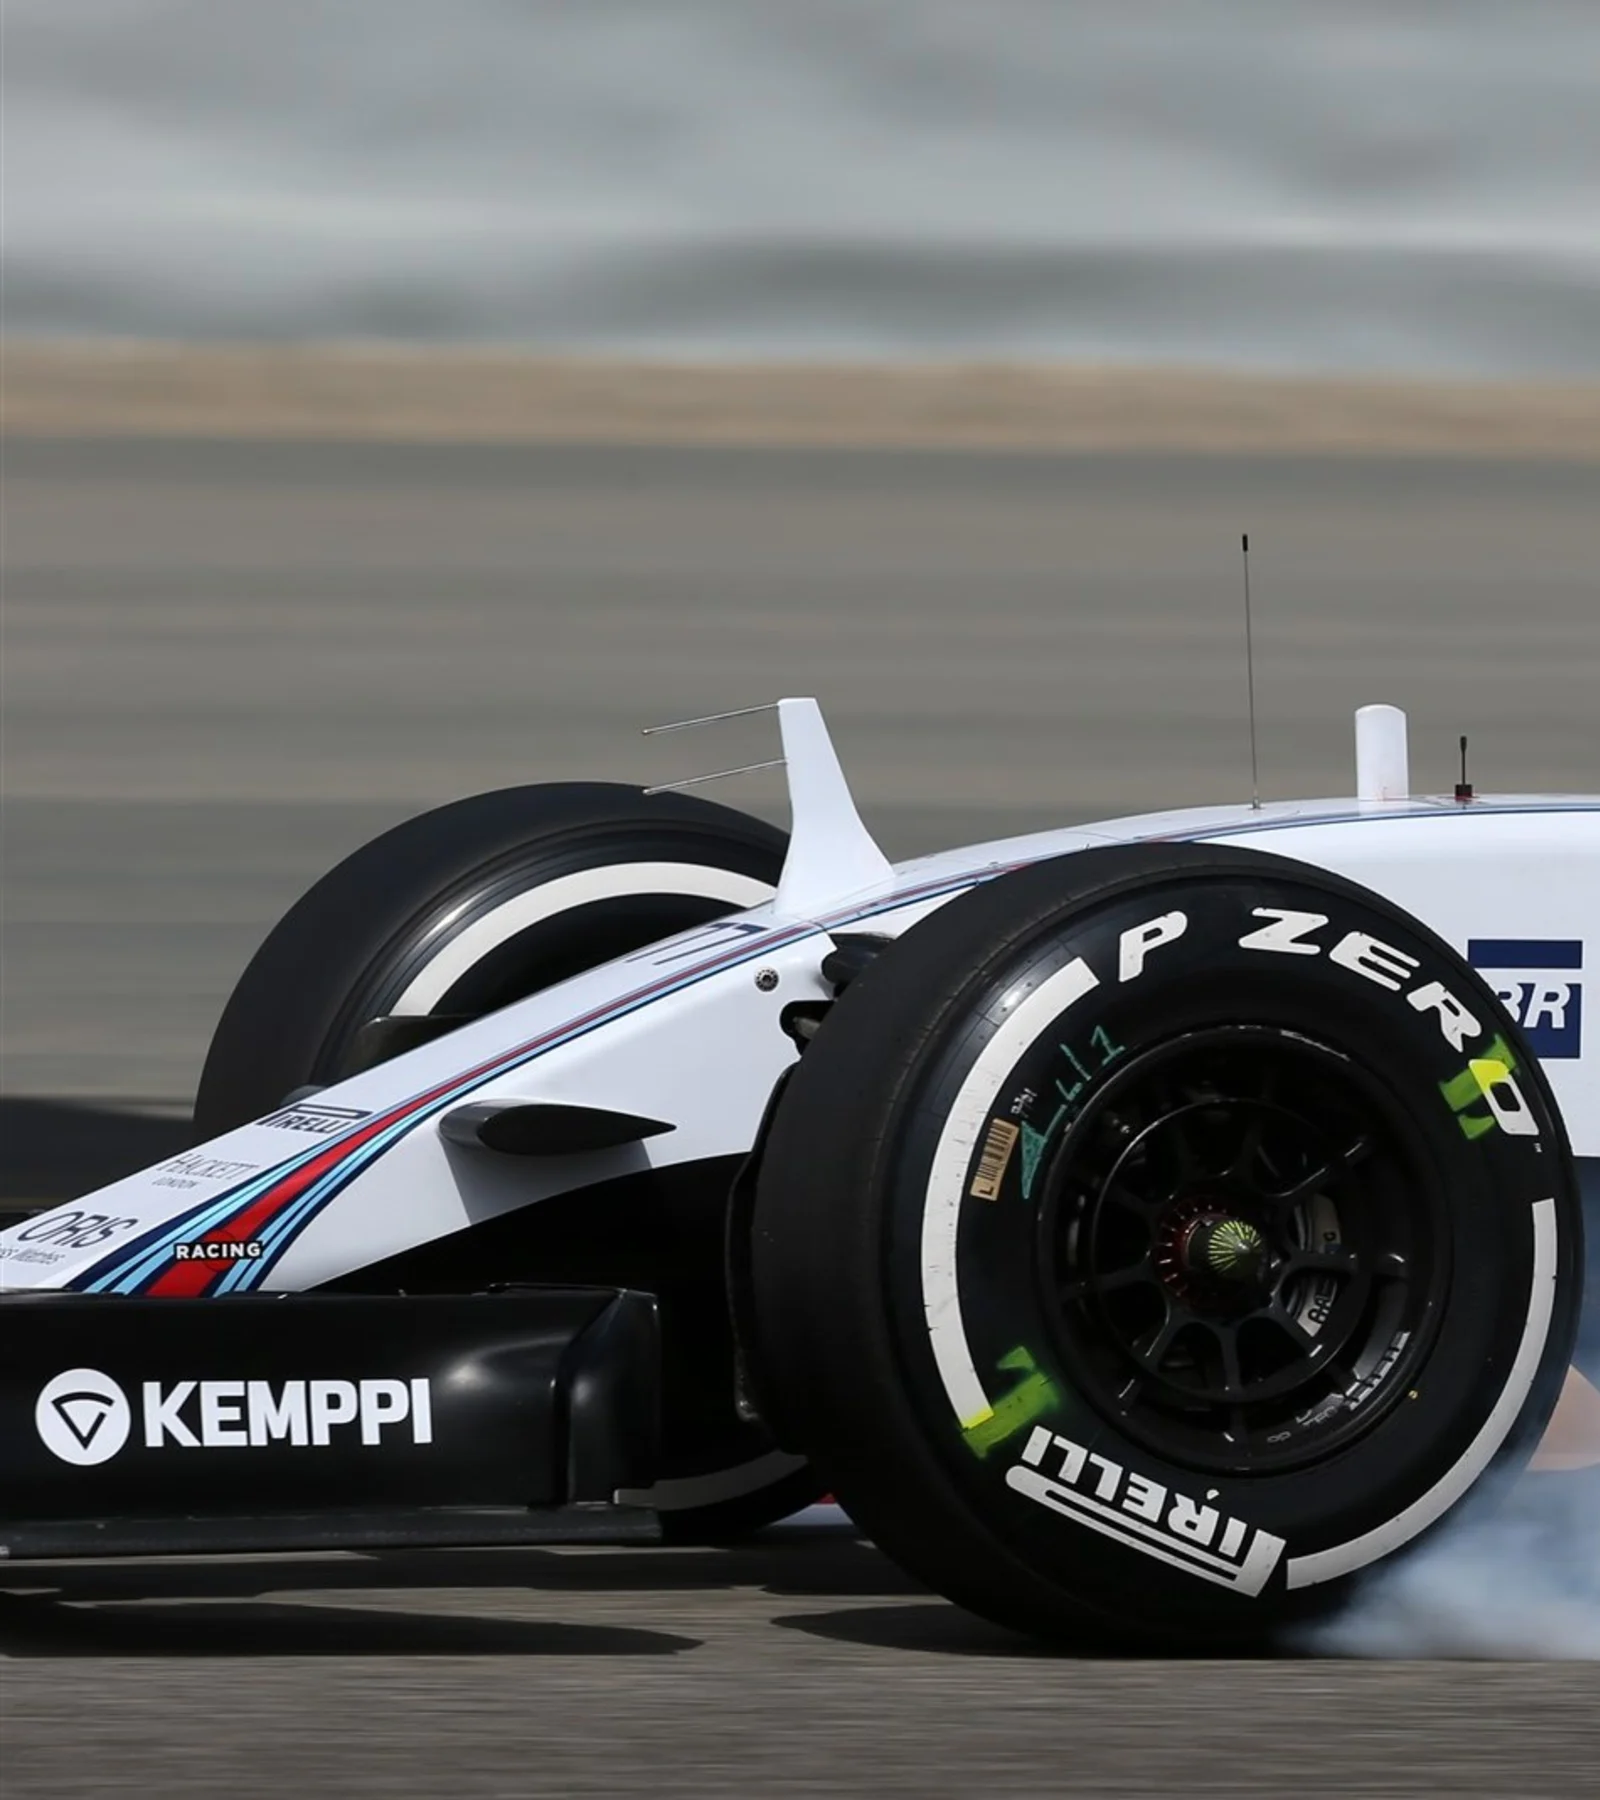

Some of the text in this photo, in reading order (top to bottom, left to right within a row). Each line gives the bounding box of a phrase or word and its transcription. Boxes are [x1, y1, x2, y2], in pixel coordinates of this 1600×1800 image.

[625, 921, 770, 966] 77
[1119, 911, 1188, 983] P
[1238, 907, 1540, 1136] ZERO
[254, 1102, 373, 1135] PIRELLI
[156, 1153, 260, 1181] HACKETT
[17, 1210, 139, 1248] ORIS
[175, 1243, 261, 1260] RACING
[144, 1378, 433, 1448] KEMPPI
[1005, 1425, 1287, 1598] PIRELLI
